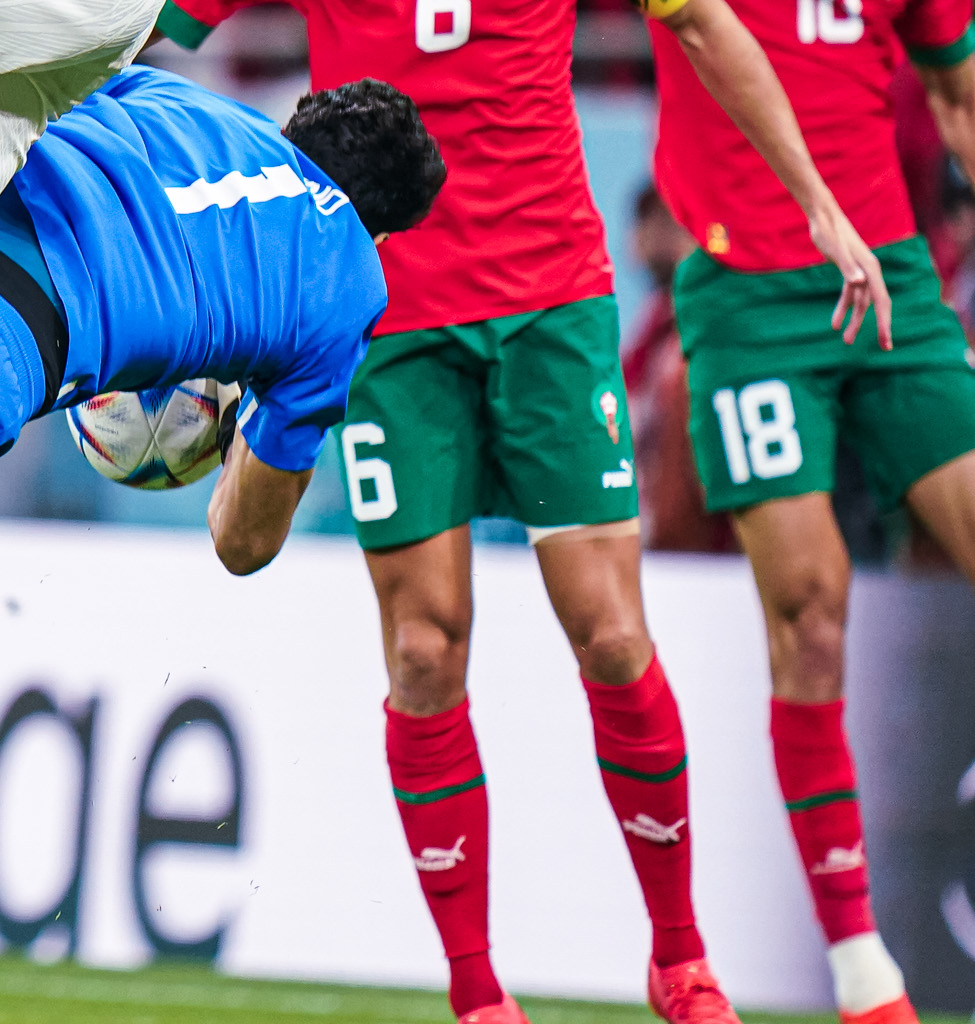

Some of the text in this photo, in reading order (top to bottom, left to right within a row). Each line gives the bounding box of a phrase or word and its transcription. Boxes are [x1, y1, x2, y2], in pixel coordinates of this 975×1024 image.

[164, 163, 307, 214] 1
[341, 422, 398, 522] 6
[714, 379, 803, 484] 18
